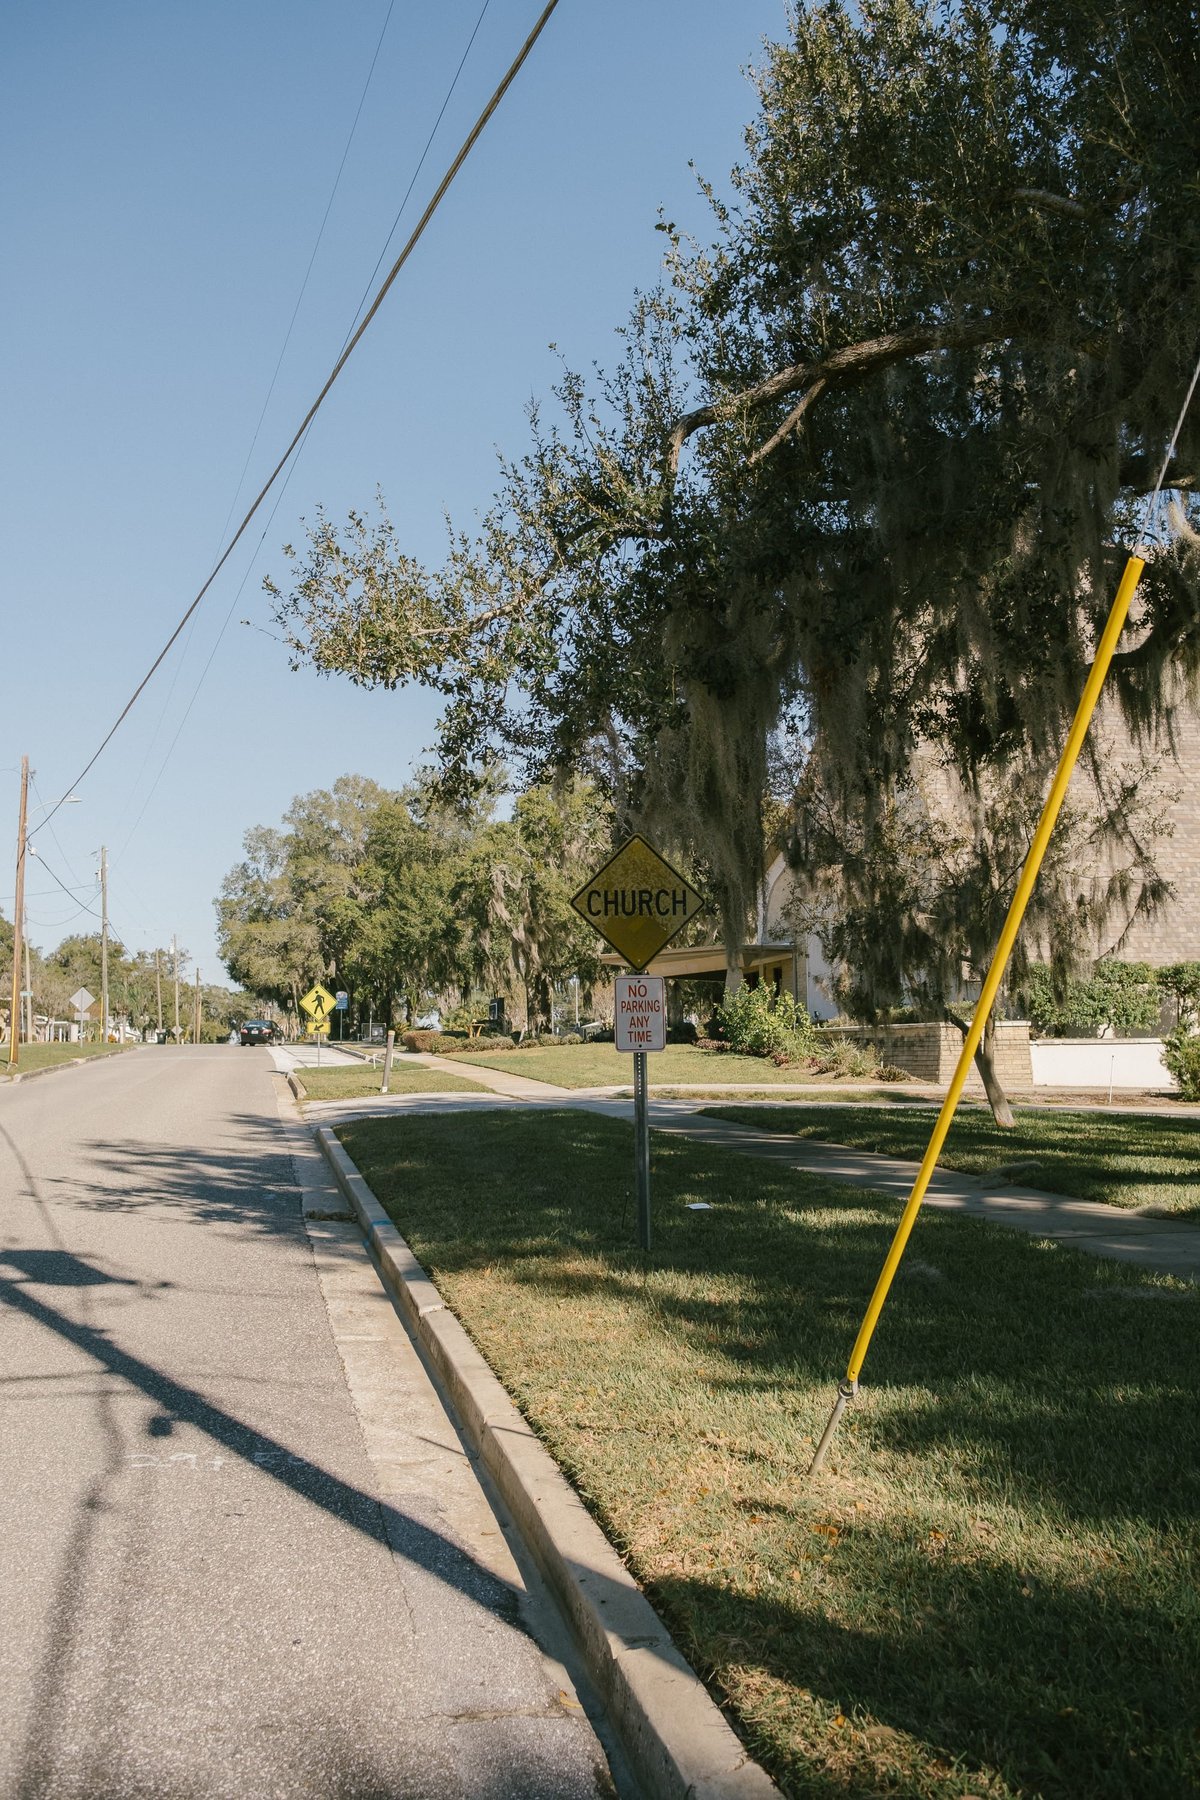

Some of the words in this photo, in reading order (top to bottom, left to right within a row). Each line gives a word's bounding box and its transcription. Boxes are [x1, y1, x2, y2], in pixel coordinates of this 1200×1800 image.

[588, 889, 687, 916] CHURCH
[628, 984, 648, 998] NO
[620, 1000, 661, 1013] PARKING
[629, 1016, 650, 1029] ANY
[627, 1030, 653, 1043] TIME
